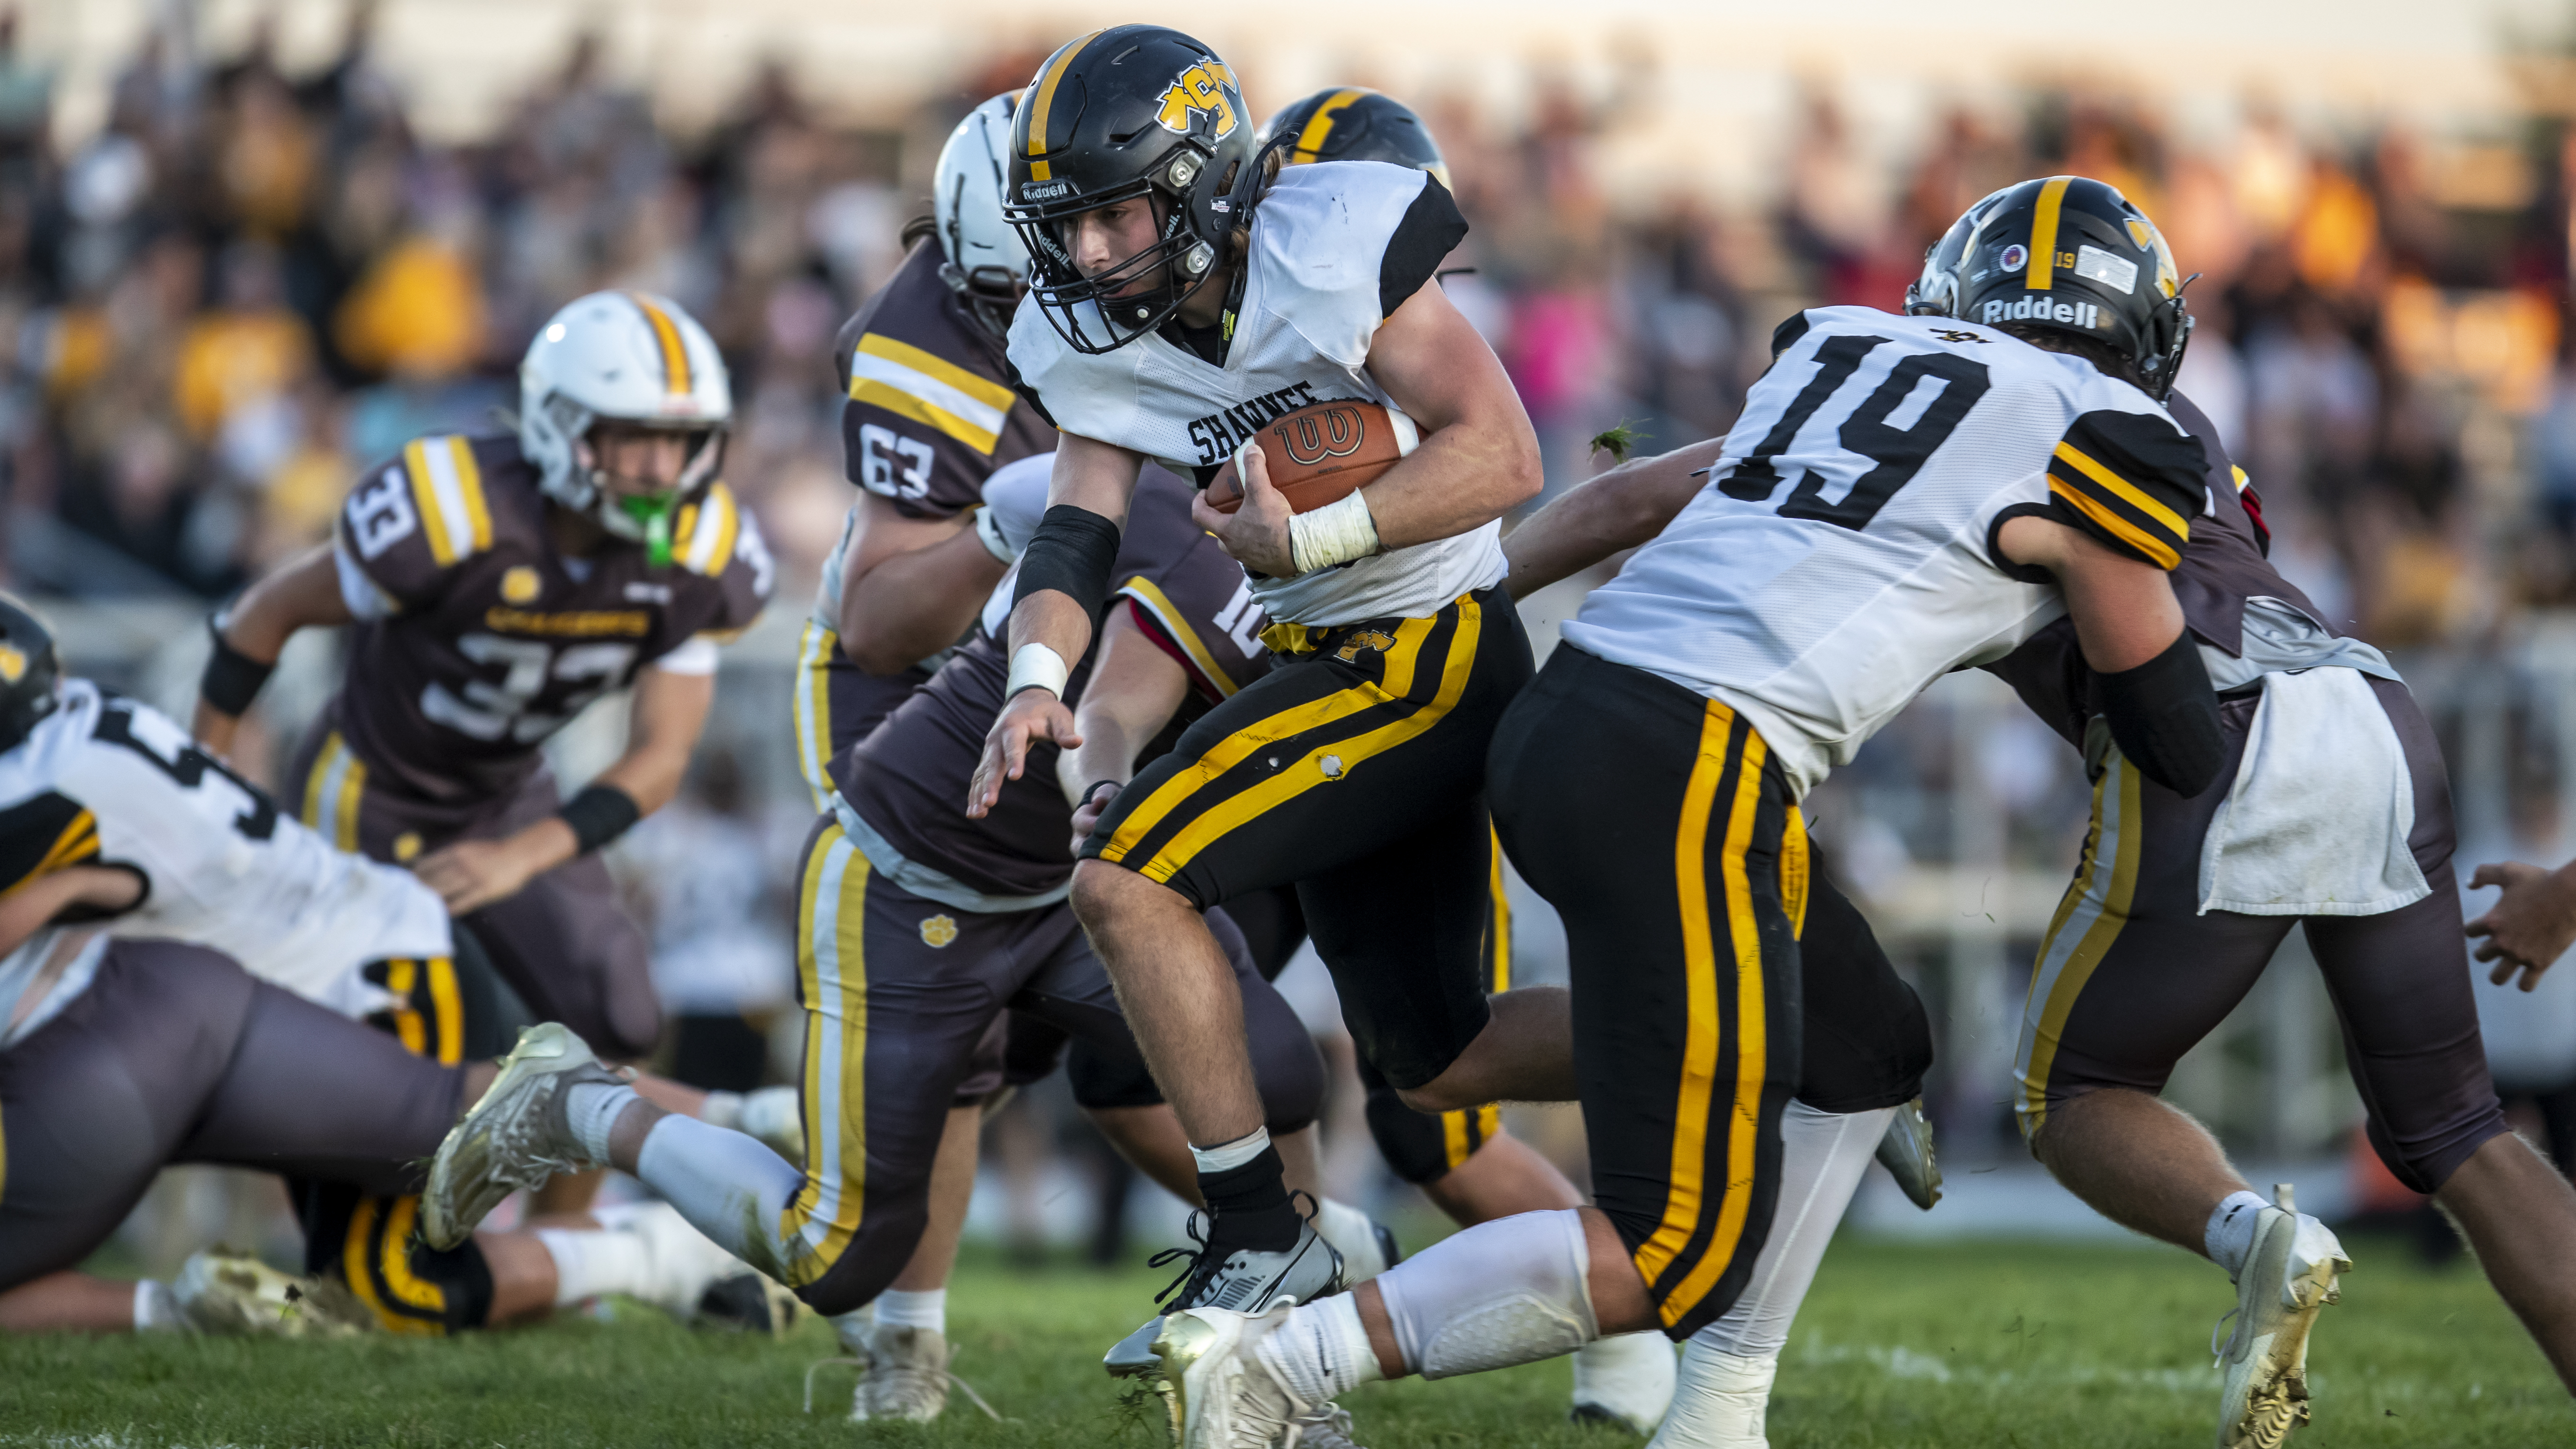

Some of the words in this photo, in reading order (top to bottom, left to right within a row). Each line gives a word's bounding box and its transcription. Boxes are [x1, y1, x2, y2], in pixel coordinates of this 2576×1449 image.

[1023, 182, 1068, 199] Riddell
[2054, 251, 2076, 269] 19
[1982, 295, 2098, 329] Riddell
[1718, 335, 1991, 531] 19
[860, 423, 934, 499] 63
[347, 466, 417, 562] 33
